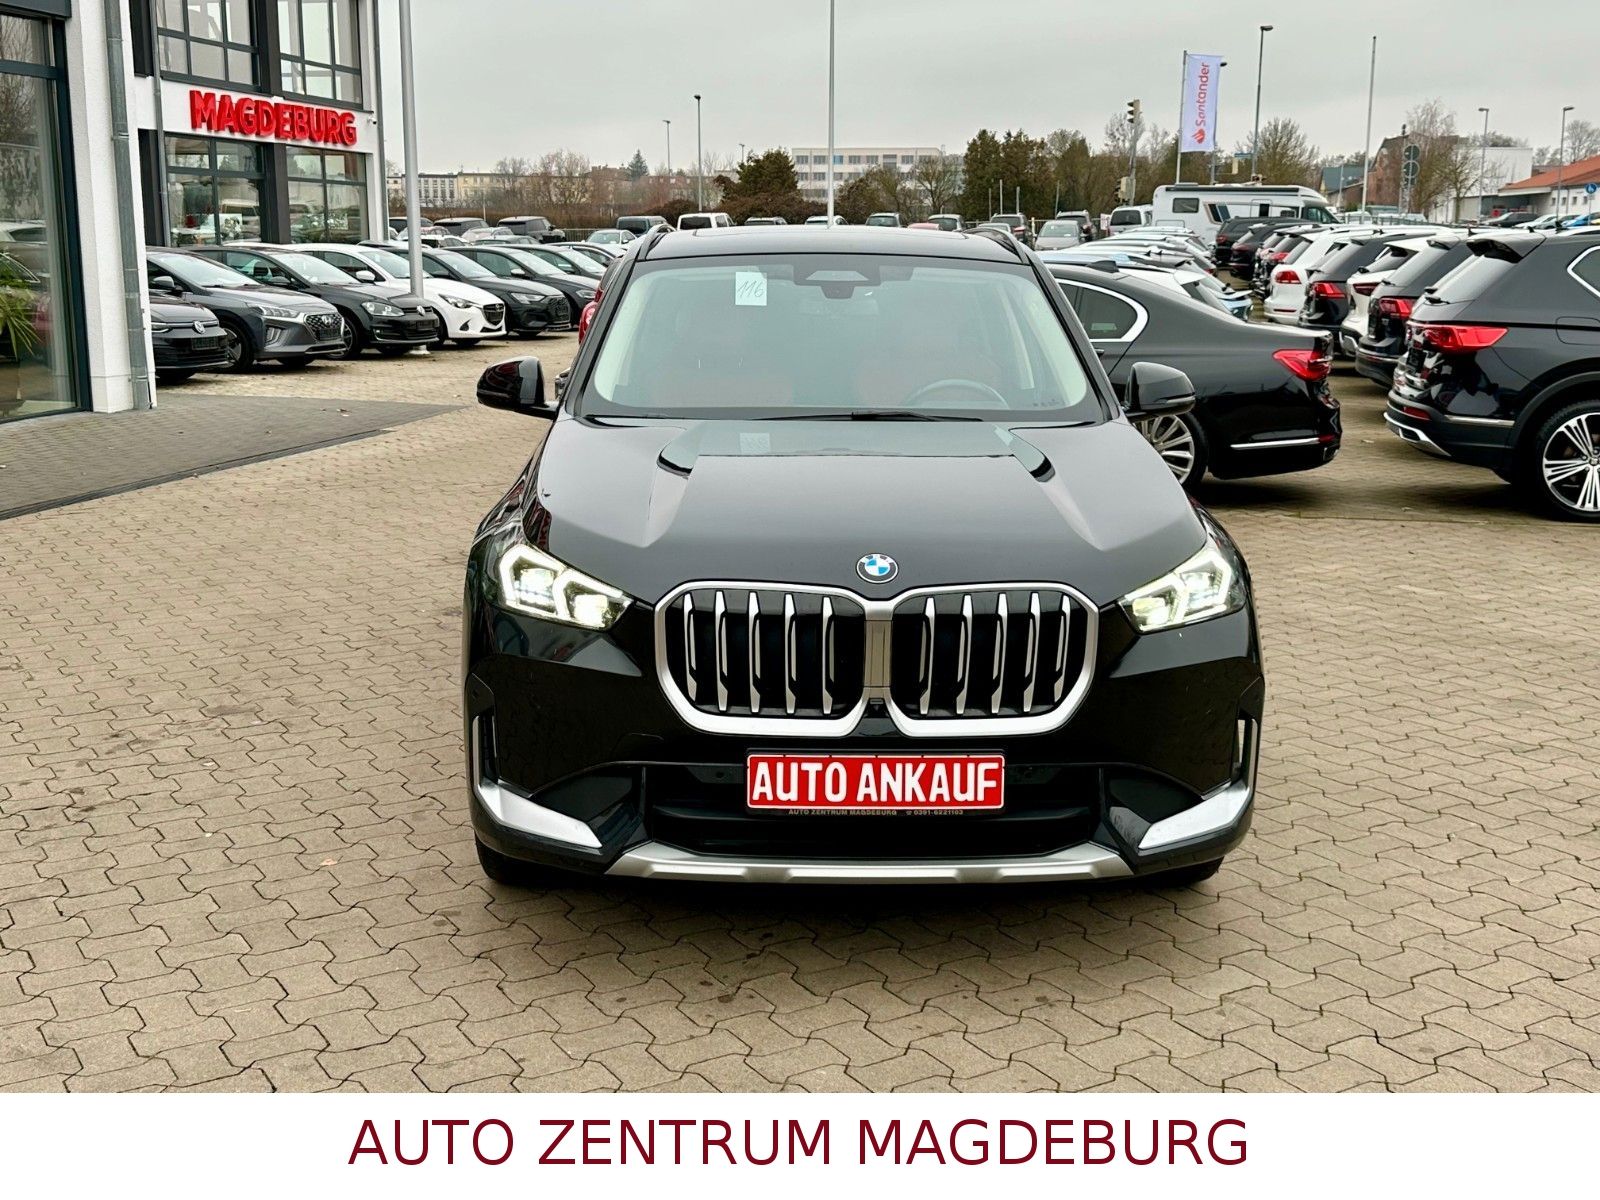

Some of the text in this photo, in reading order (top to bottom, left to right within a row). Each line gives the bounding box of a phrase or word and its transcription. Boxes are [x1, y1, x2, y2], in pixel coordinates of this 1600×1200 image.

[189, 90, 357, 146] MAGDEBURG
[1195, 62, 1210, 126] Santander
[752, 761, 1000, 802] AUTO ANKAUF
